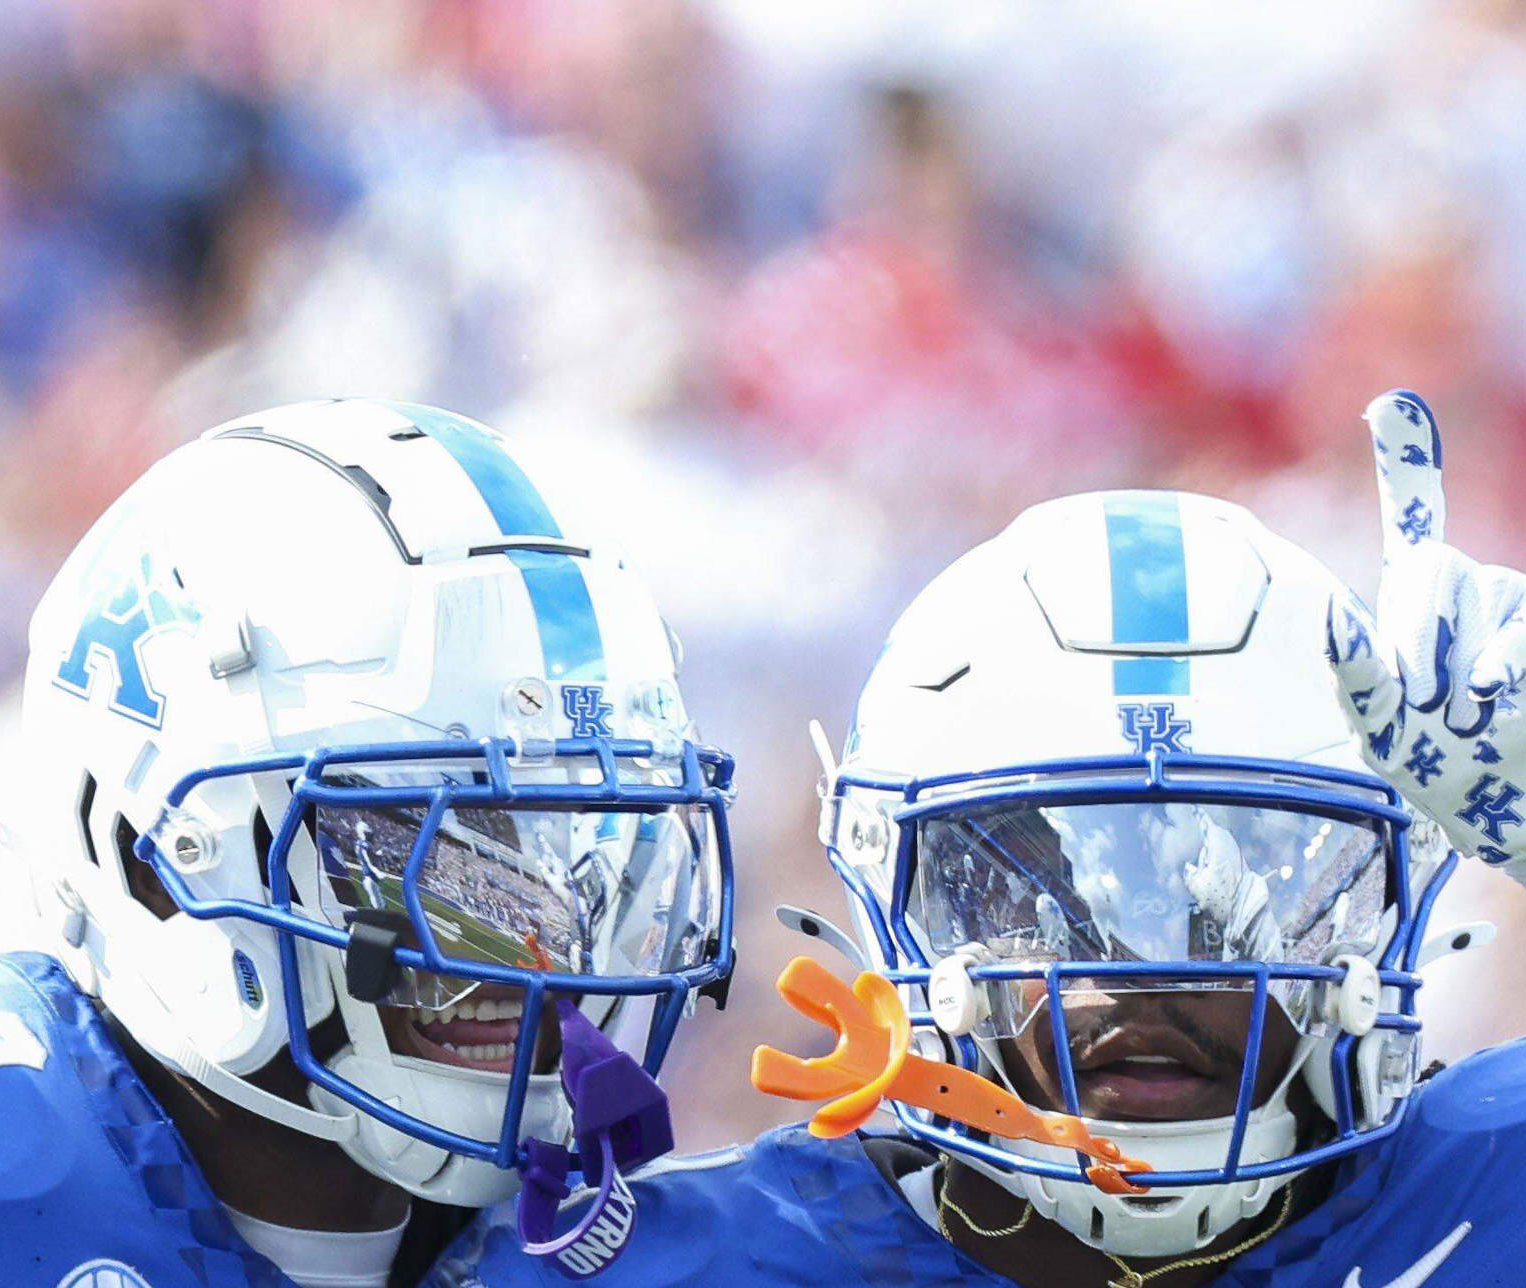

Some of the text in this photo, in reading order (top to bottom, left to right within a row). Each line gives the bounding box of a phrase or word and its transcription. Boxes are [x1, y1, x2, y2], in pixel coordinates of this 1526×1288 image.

[562, 685, 615, 738] UK
[1117, 702, 1192, 755] UK
[1454, 771, 1526, 846] UK
[557, 1164, 637, 1276] XTRND
